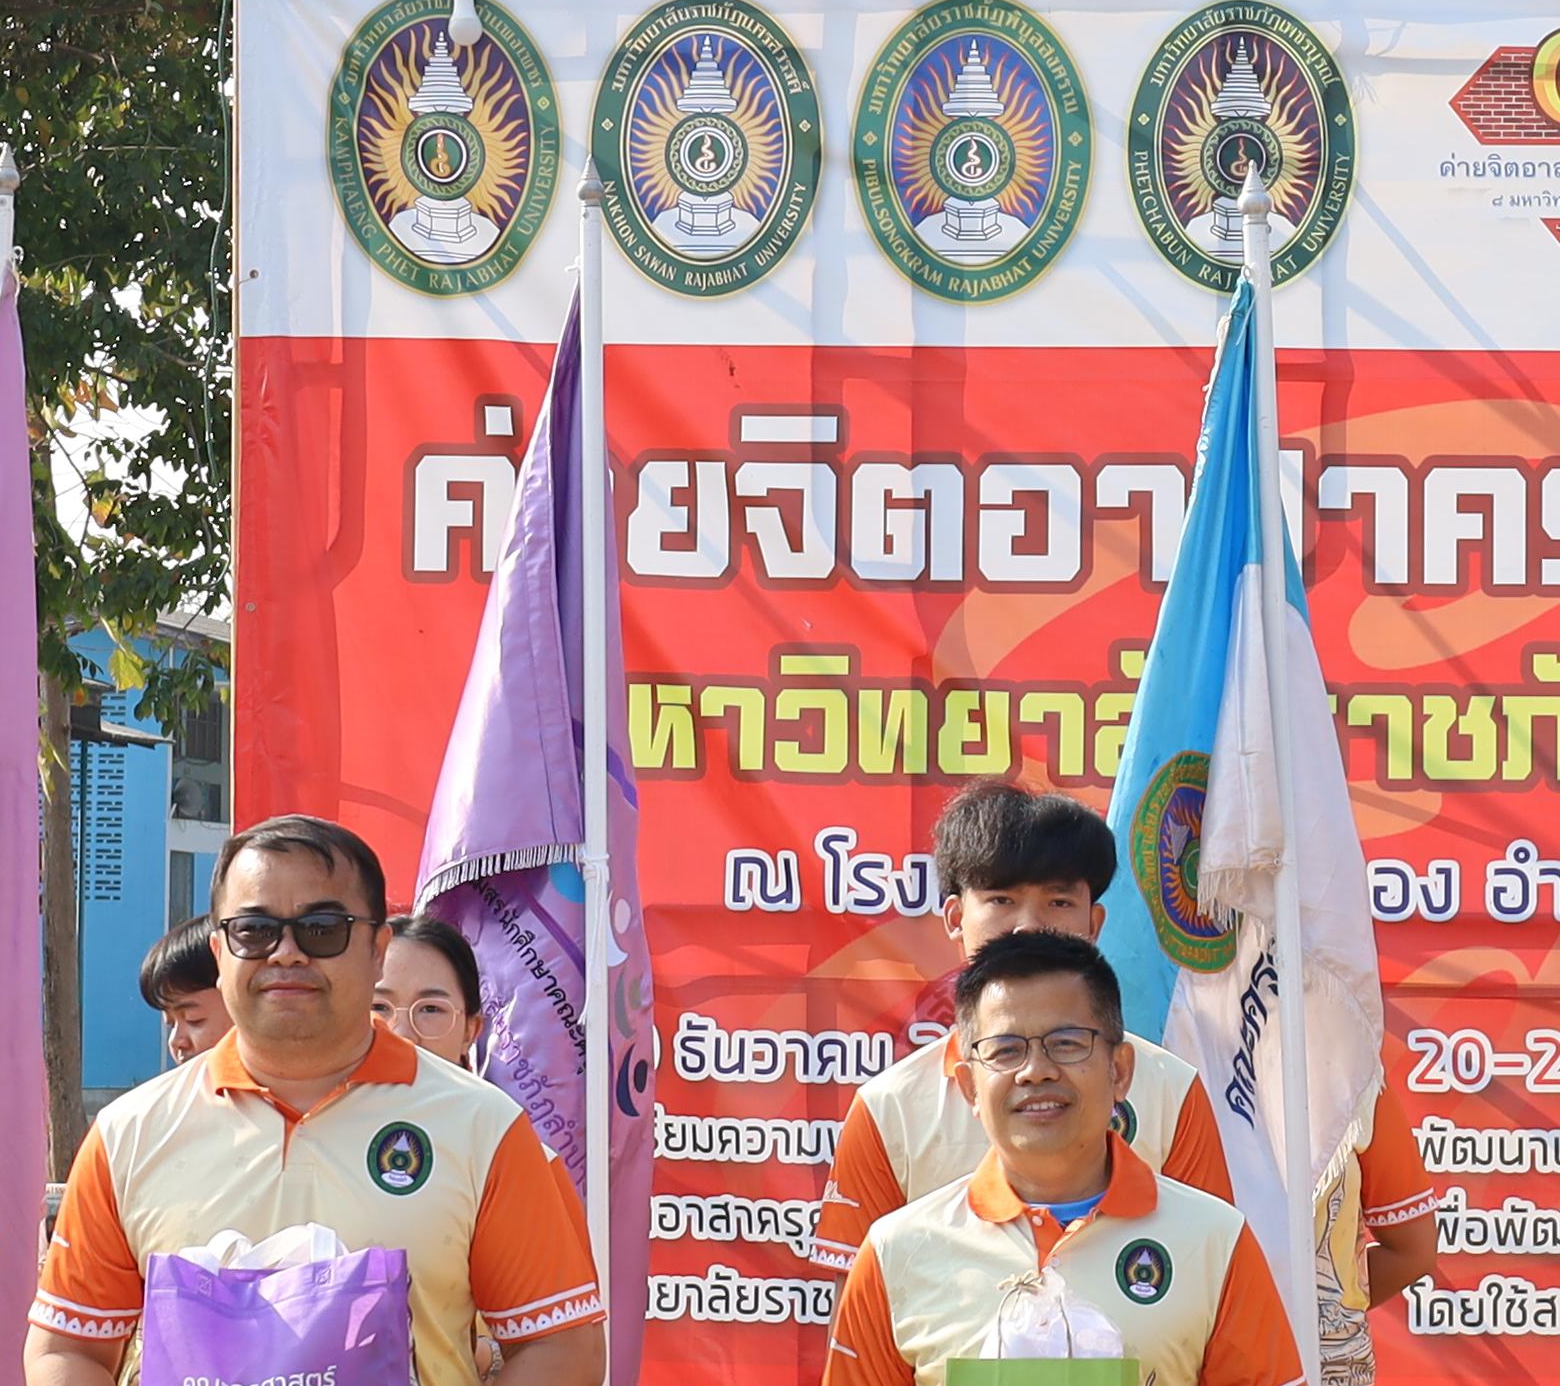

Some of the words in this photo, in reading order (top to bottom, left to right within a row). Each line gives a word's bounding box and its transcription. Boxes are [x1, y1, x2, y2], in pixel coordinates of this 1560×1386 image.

[335, 117, 377, 240] KAMPHAENG
[377, 242, 418, 282] PHET
[428, 244, 518, 292] RAJABHAT
[521, 123, 554, 237] UNIVERSITY
[604, 180, 638, 248] NAKHON
[634, 246, 677, 280] SAWAN
[684, 263, 747, 288] RAJABHAT
[755, 182, 807, 266] UNIVERSITY
[863, 158, 944, 287] PIBULSONGKRAM
[949, 261, 1033, 297] RAJABHAT
[1033, 159, 1082, 260] UNIVERSITY
[1135, 150, 1191, 265] PHETCHABUN
[1199, 256, 1298, 288] RAJAT
[1303, 151, 1351, 252] UNIVERSITY
[816, 827, 941, 915] โรง
